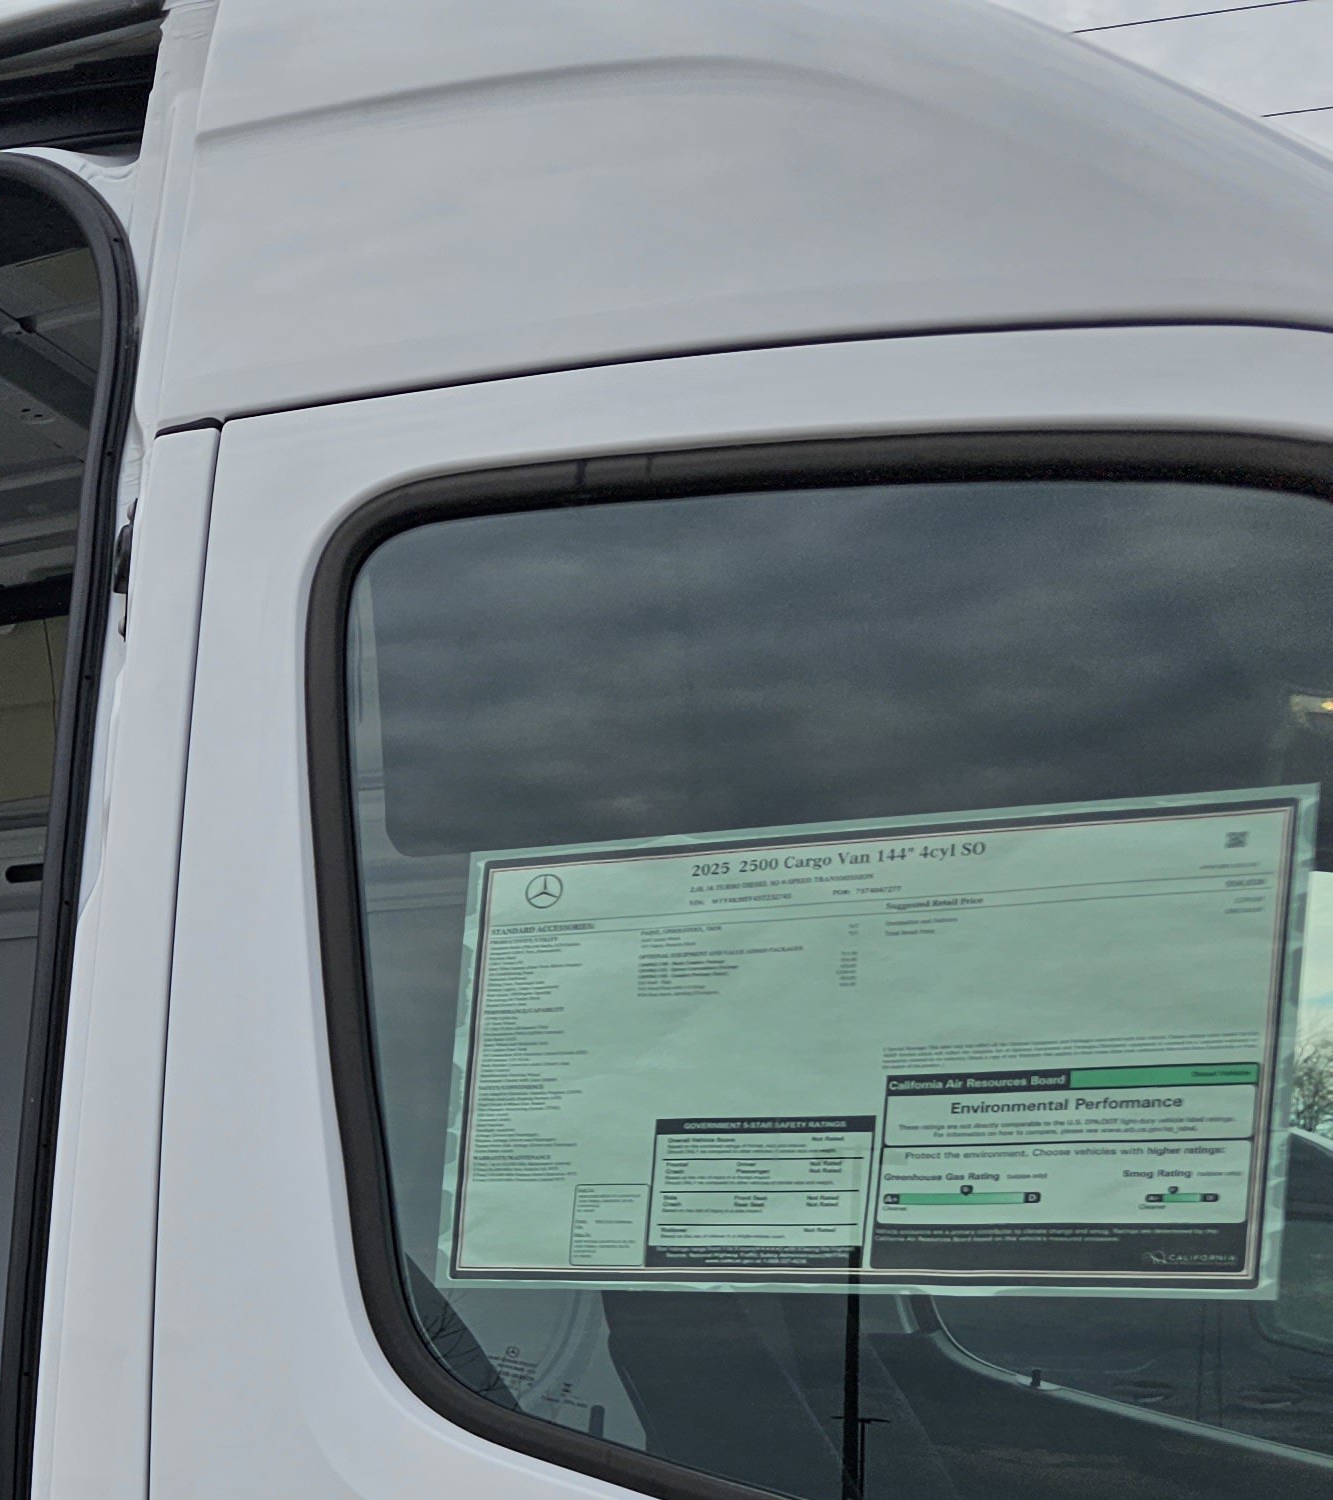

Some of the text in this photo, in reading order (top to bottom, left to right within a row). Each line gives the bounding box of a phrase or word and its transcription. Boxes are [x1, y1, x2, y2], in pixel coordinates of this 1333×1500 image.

[691, 841, 986, 877] 2025 2500 Cargo Van 144" 4cyl SO
[885, 897, 984, 911] Suggested Retail Price
[492, 926, 536, 936] STANDARD
[889, 1075, 1065, 1090] California Air Resources Board
[950, 1095, 1184, 1114] Environmental Performance
[683, 1120, 847, 1130] GOVERNMENT 5-STAR SAFETY RATINGS
[904, 1151, 941, 1159] Protect
[943, 1151, 960, 1159] the
[963, 1149, 1029, 1159] environment.
[1032, 1147, 1070, 1157] Choose
[1074, 1147, 1117, 1156] vehicles
[1120, 1147, 1143, 1155] with
[1147, 1146, 1180, 1157] higher
[884, 1173, 942, 1181] Greenhouse
[945, 1173, 965, 1181] Gas
[967, 1172, 1000, 1182] Rating
[1122, 1169, 1154, 1179] Smog
[1157, 1169, 1192, 1179] Rating
[1168, 1254, 1235, 1262] CALIFORNIA
